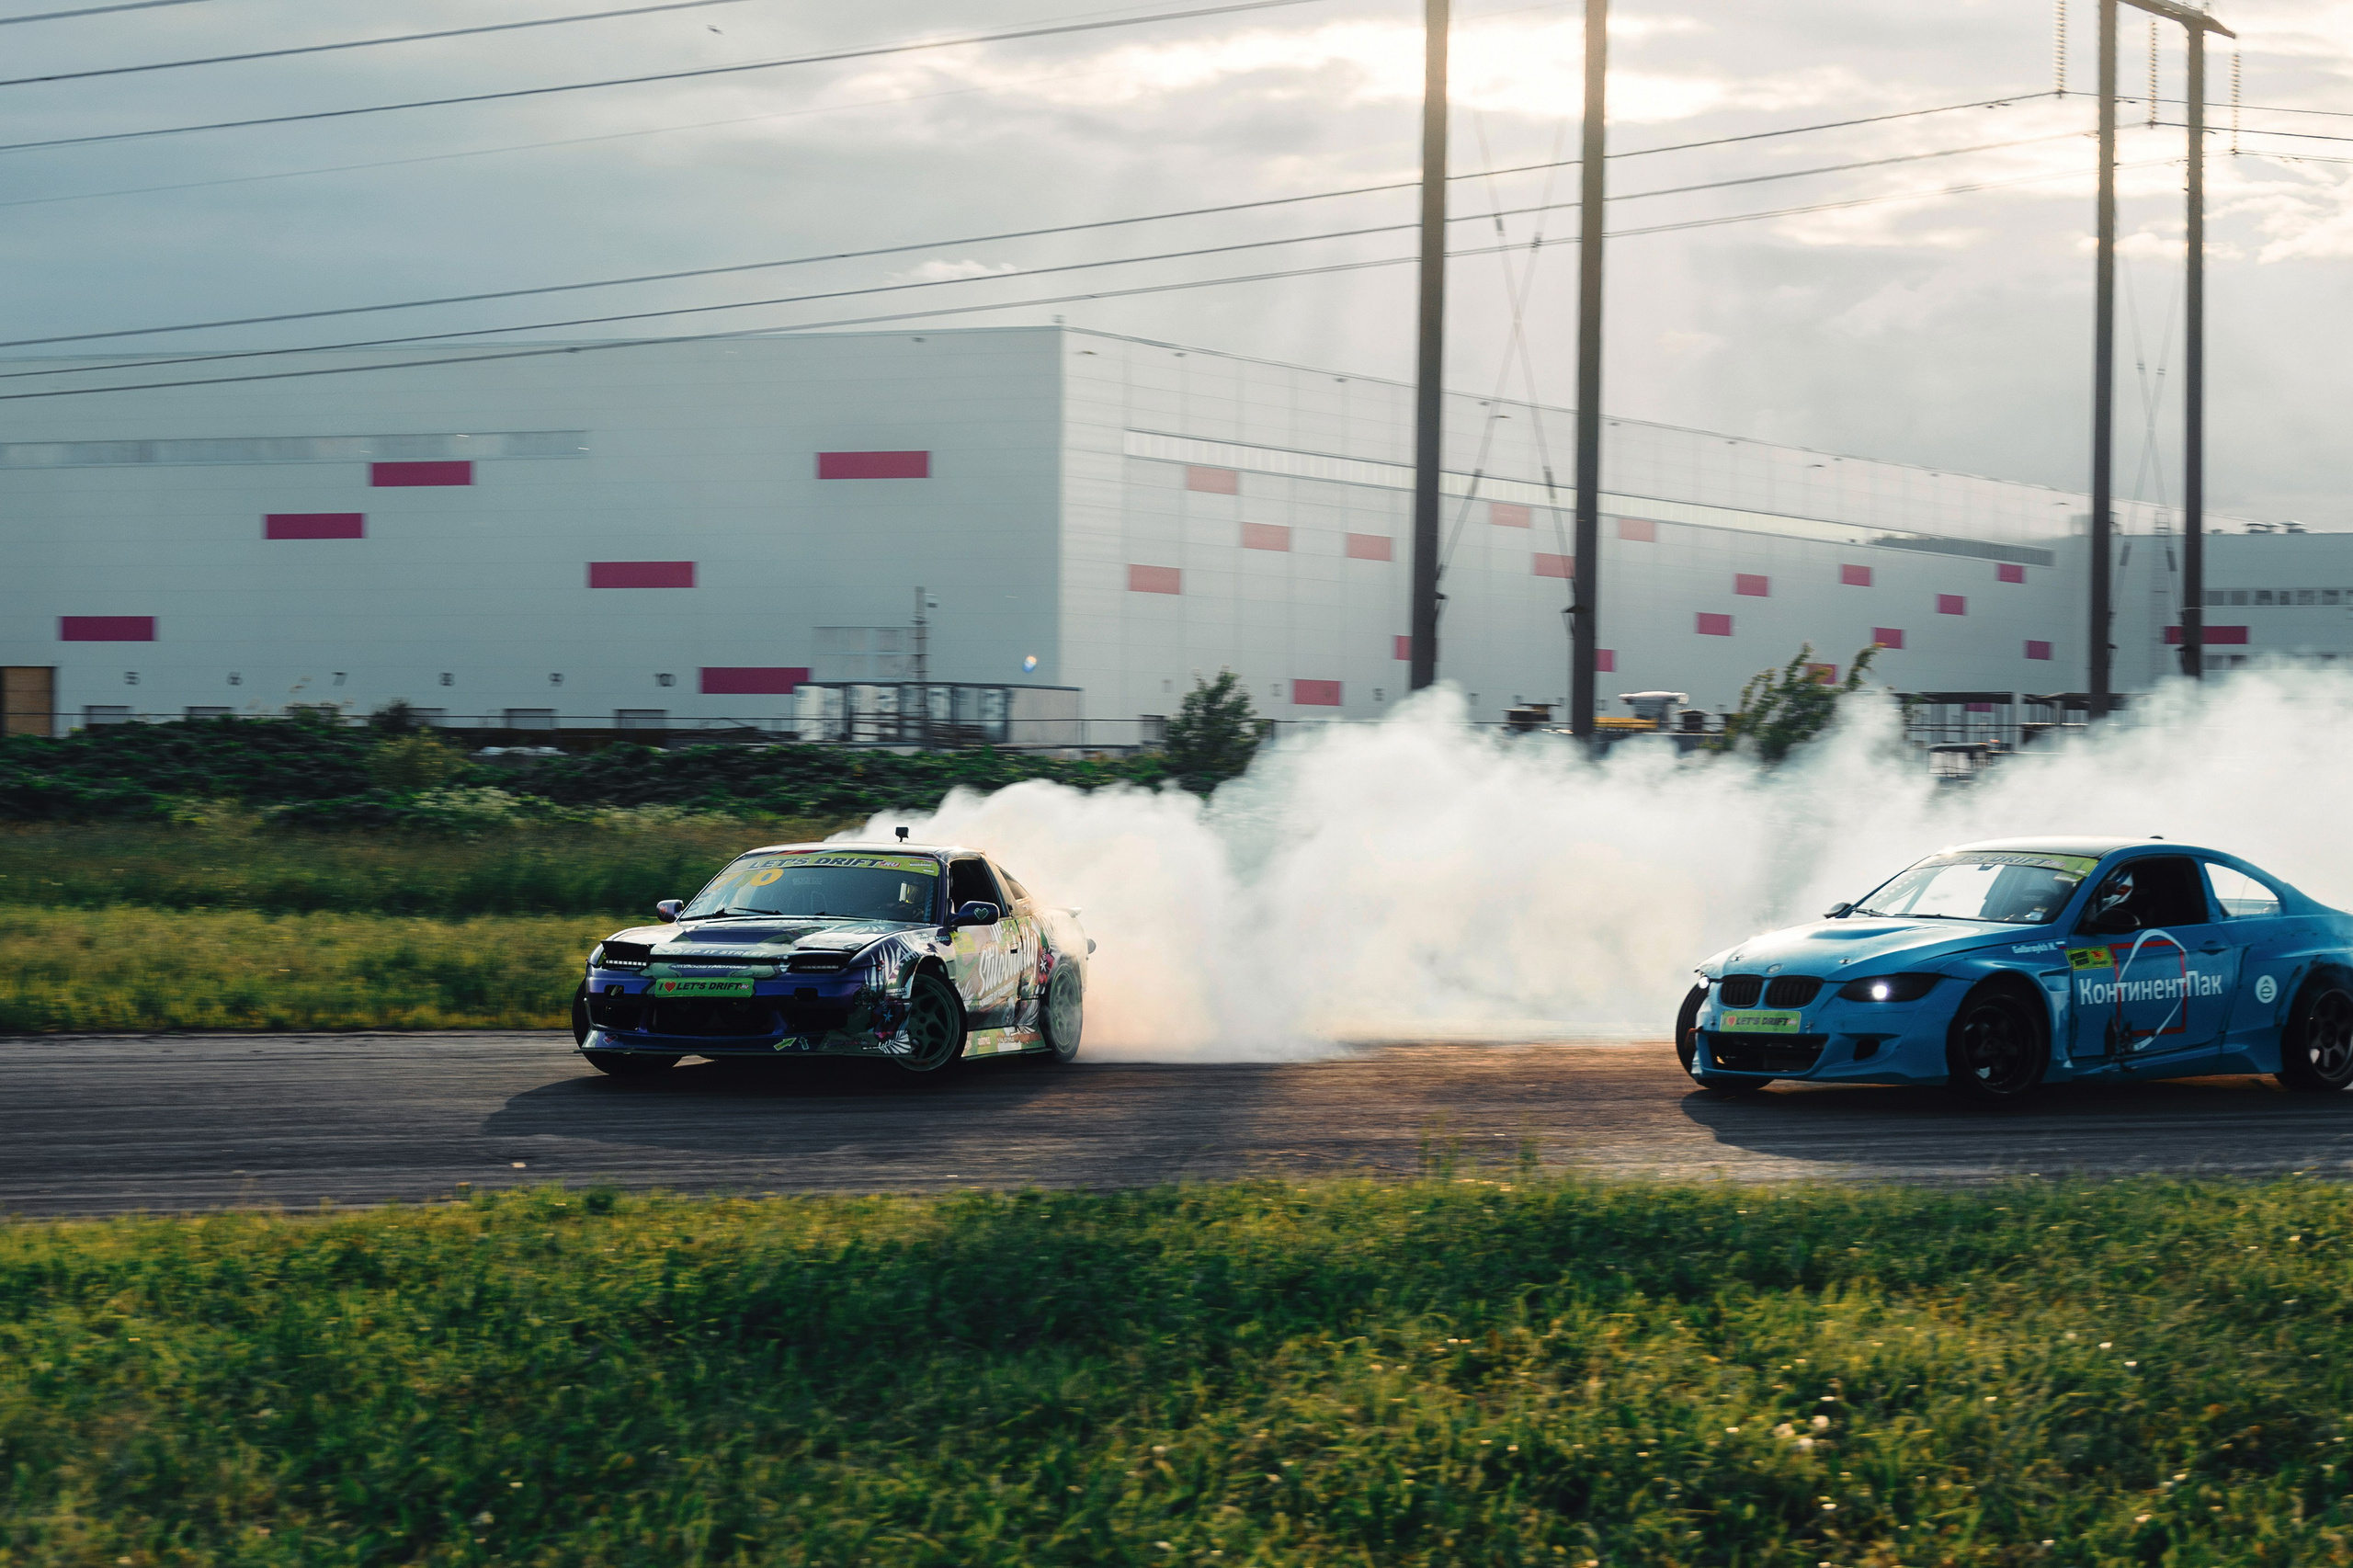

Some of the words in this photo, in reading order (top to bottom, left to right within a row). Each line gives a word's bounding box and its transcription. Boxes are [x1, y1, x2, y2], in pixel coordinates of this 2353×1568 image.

[749, 857, 809, 869] LET'S
[658, 983, 664, 991] I
[676, 982, 708, 991] LET'S
[2078, 971, 2222, 1005] КонтинентПак
